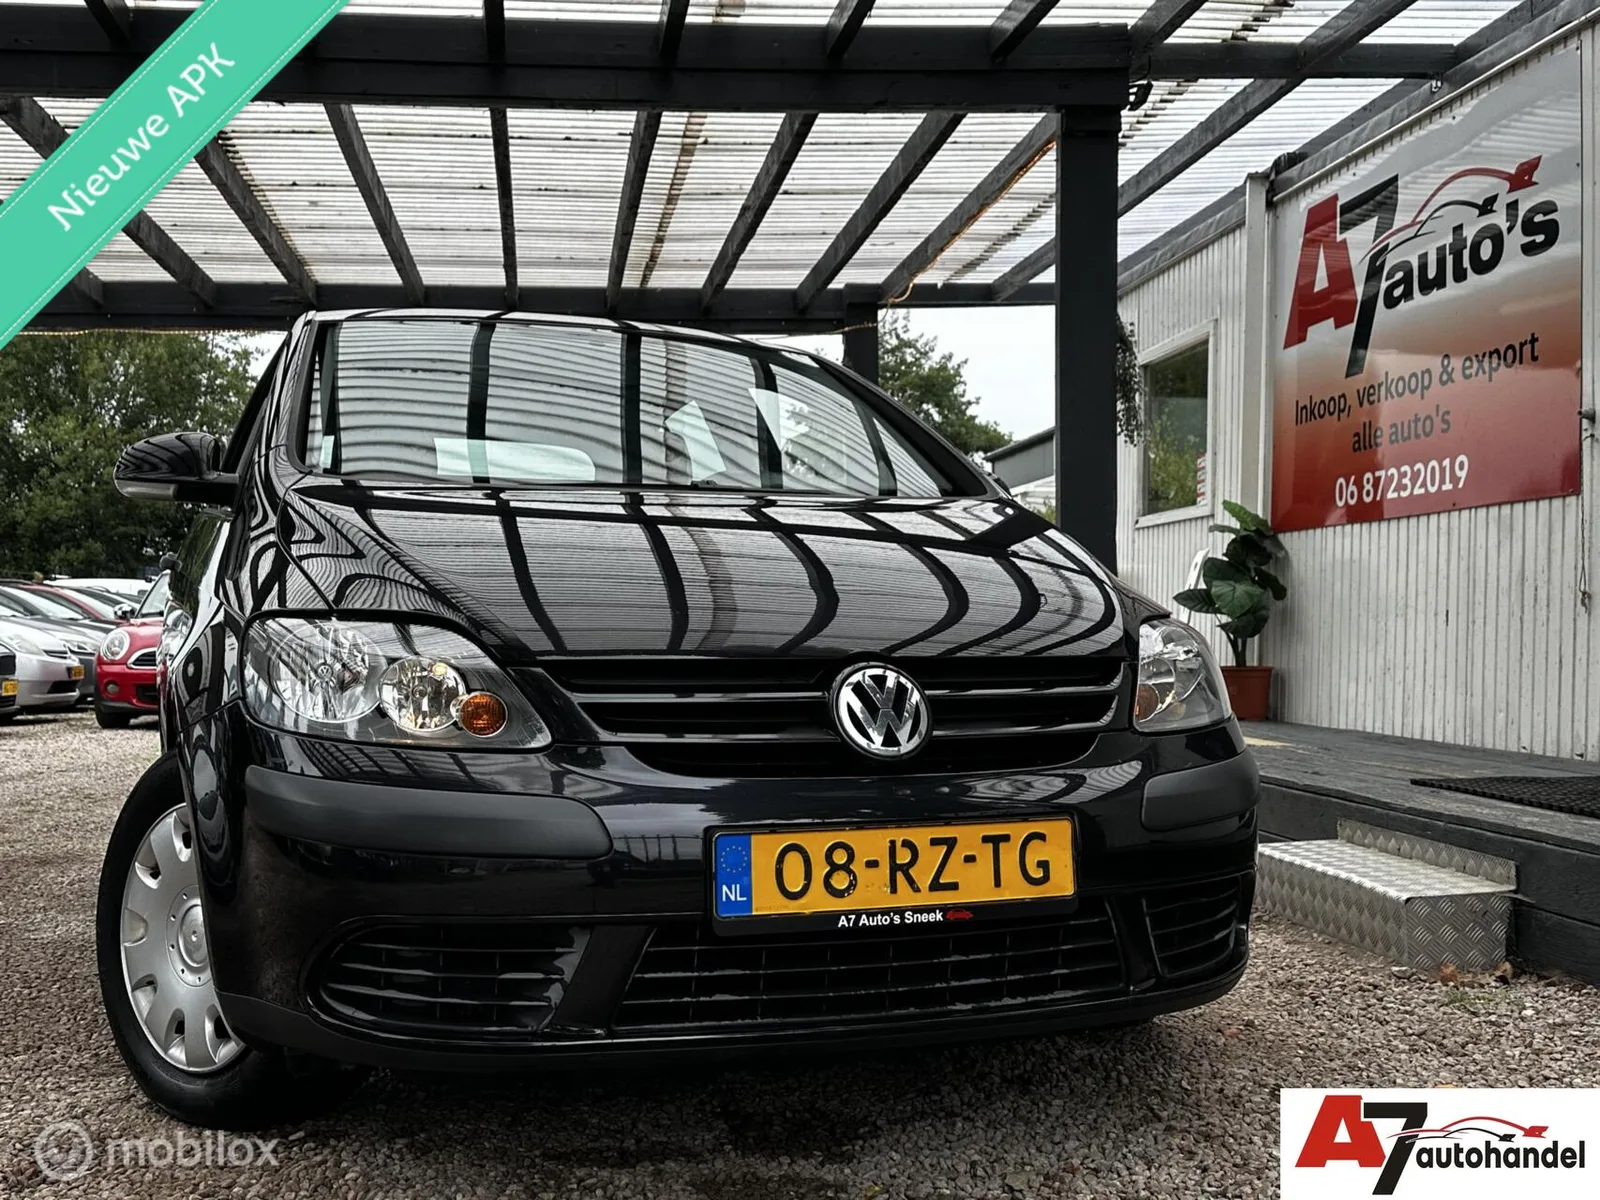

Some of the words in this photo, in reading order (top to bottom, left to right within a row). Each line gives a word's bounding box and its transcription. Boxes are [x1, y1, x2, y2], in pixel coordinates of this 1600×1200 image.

[1283, 173, 1399, 379] A7
[1383, 199, 1560, 310] auto’s
[1294, 392, 1352, 426] Inkoop,
[1356, 367, 1433, 408] verkoop
[1438, 353, 1456, 387] &
[1461, 332, 1540, 382] export
[1352, 421, 1384, 453] alle
[1388, 404, 1451, 446] auto's
[1335, 475, 1359, 507] 06
[1362, 454, 1469, 503] 87232019
[774, 830, 1051, 901] 08-RZ-TG
[722, 883, 748, 902] NL
[838, 914, 856, 928] A7
[904, 909, 944, 924] Sneek
